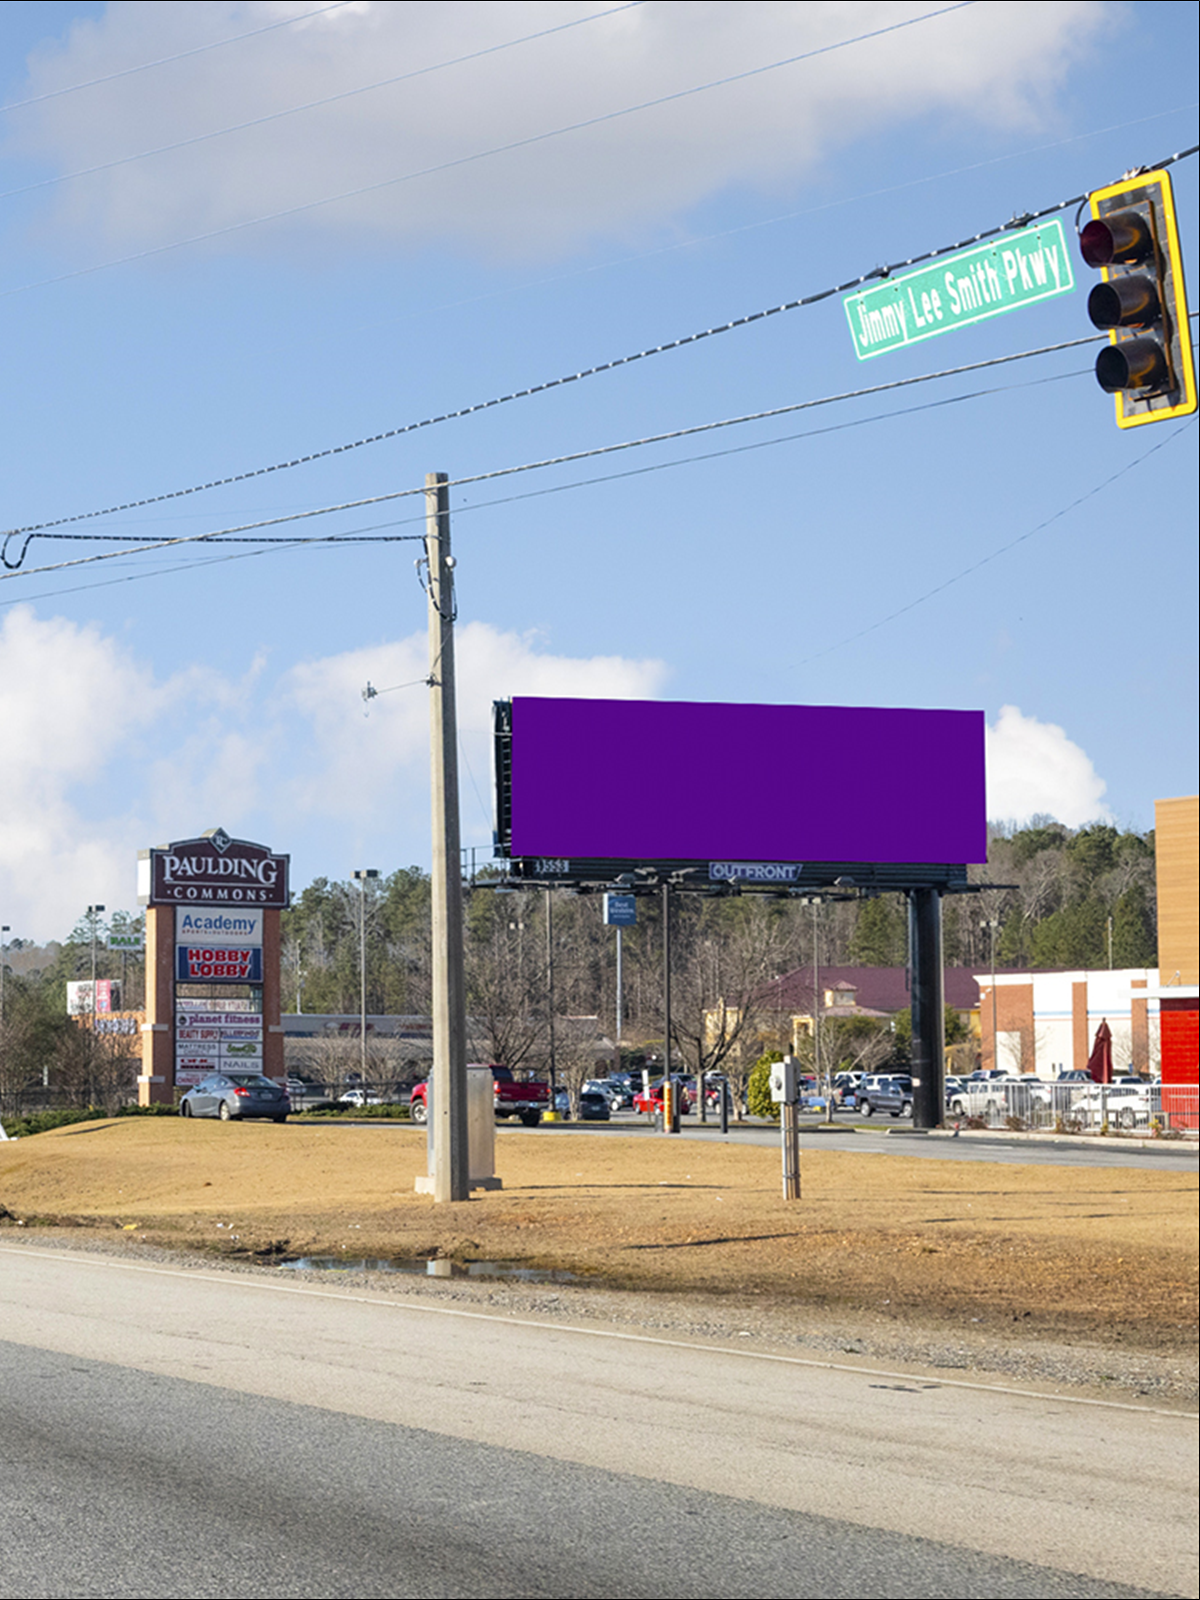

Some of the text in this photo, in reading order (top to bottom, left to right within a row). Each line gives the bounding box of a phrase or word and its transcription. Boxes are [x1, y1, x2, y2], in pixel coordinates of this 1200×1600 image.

[856, 243, 1061, 348] Jimmy Lee Smith Pkwy
[162, 855, 278, 885] PAULDING
[713, 864, 797, 879] OUTFRONT
[173, 886, 267, 902] COMMONS
[182, 914, 257, 935] Academy
[187, 948, 252, 963] HOBBY
[189, 963, 251, 978] LOBBY
[189, 1014, 261, 1026] planet fitness
[223, 1060, 260, 1069] NAILS
